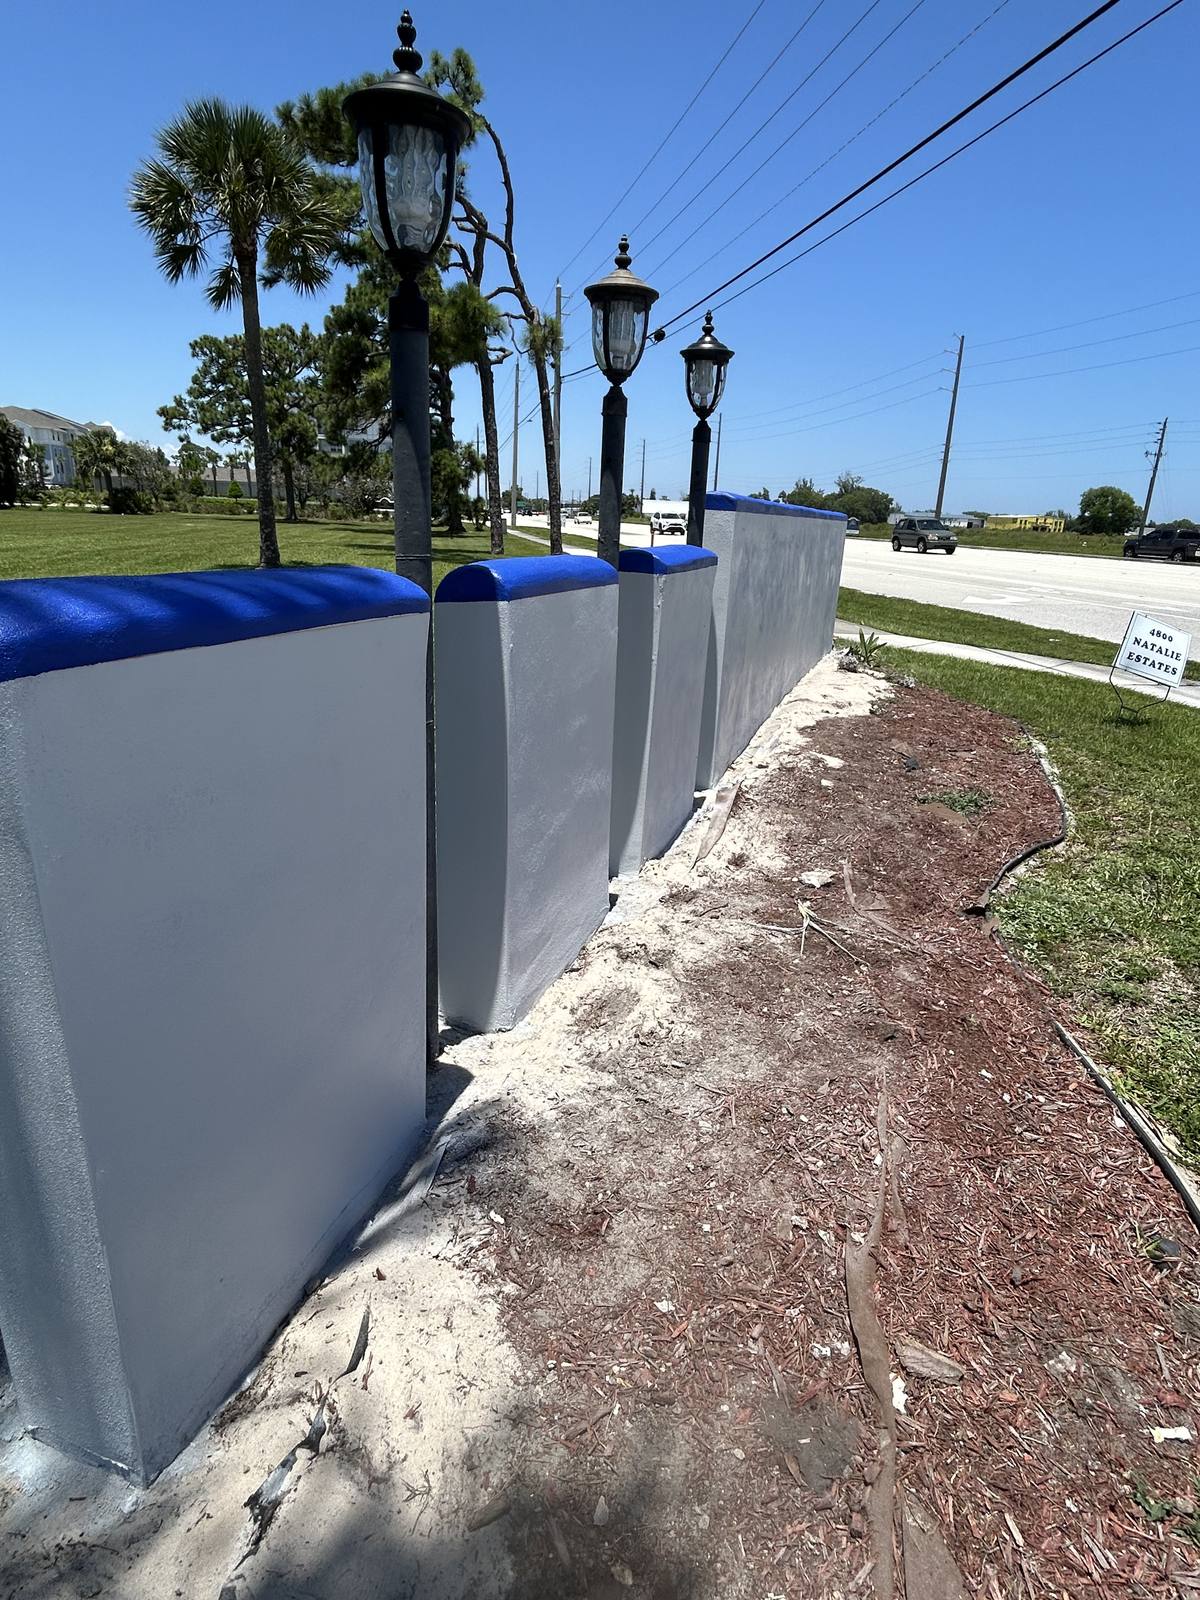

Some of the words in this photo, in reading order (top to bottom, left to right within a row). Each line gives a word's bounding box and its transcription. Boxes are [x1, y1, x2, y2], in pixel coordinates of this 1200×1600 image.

[1149, 629, 1173, 642] 4800
[1133, 636, 1182, 661] NATALIE
[1127, 652, 1178, 675] ESTATES
